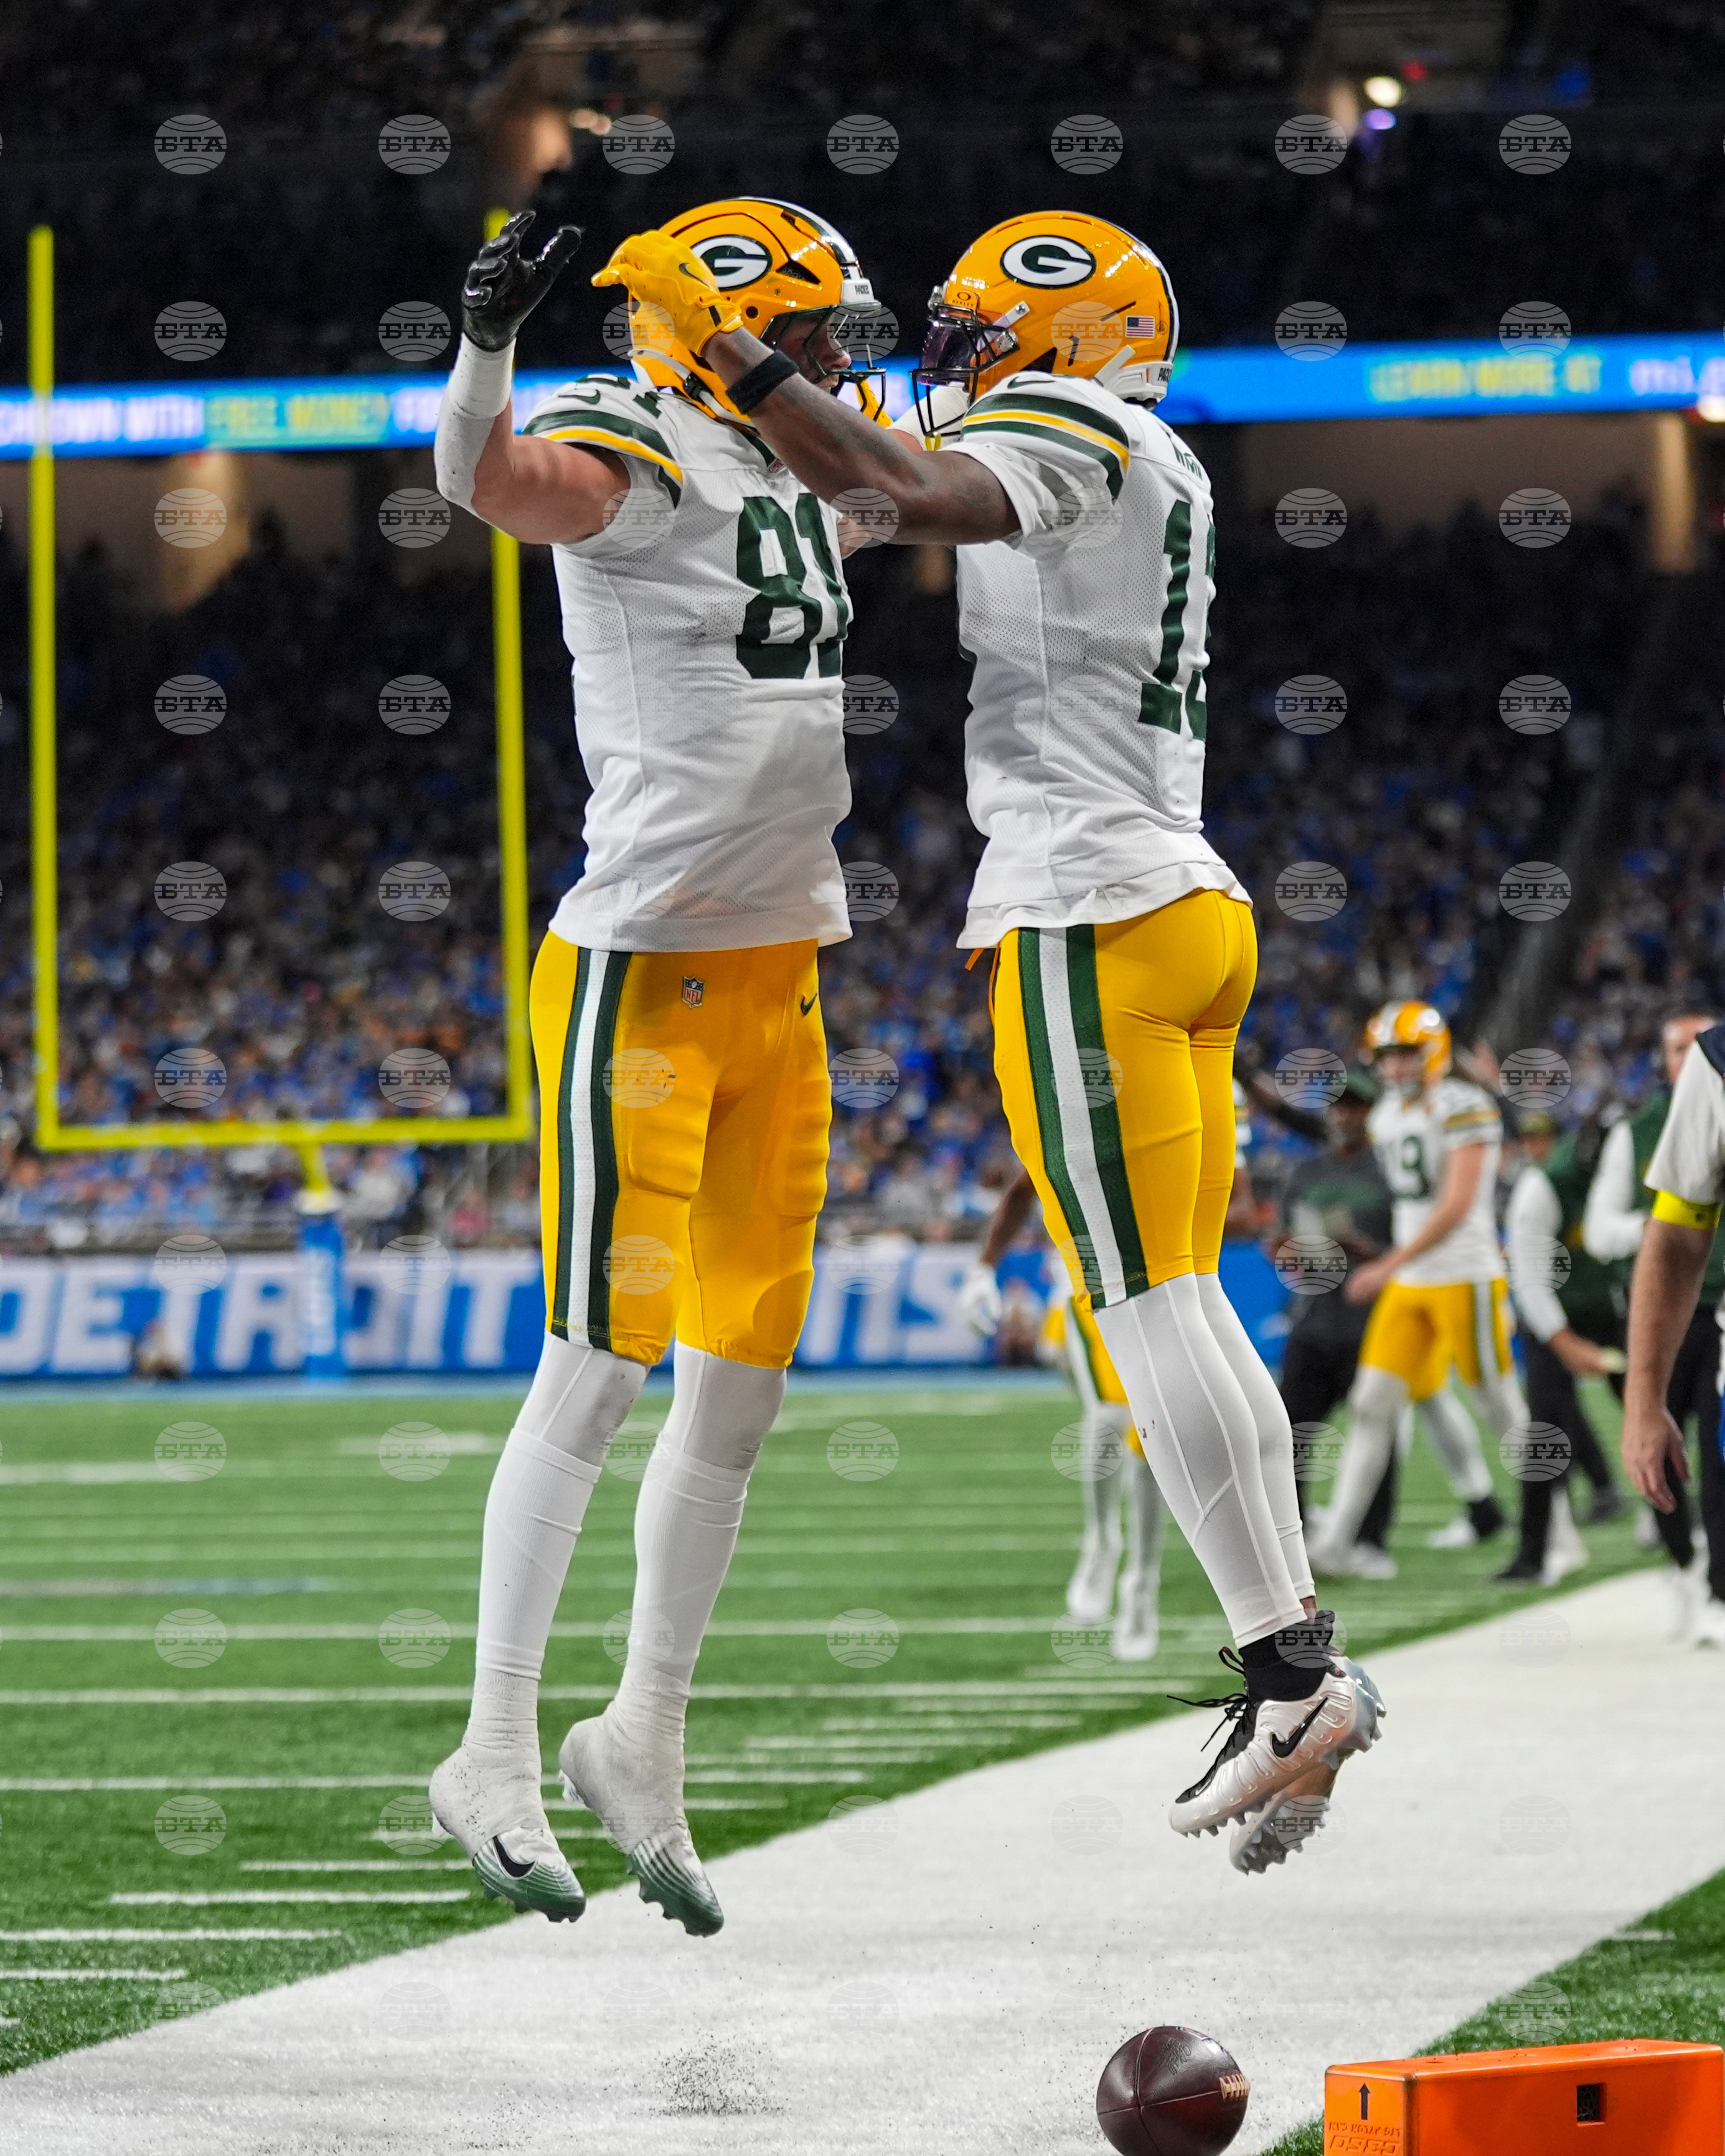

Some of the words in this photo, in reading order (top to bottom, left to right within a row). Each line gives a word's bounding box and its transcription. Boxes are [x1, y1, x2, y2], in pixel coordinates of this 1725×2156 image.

[690, 234, 773, 291] G
[1000, 235, 1096, 289] G
[685, 988, 701, 1003] NFL
